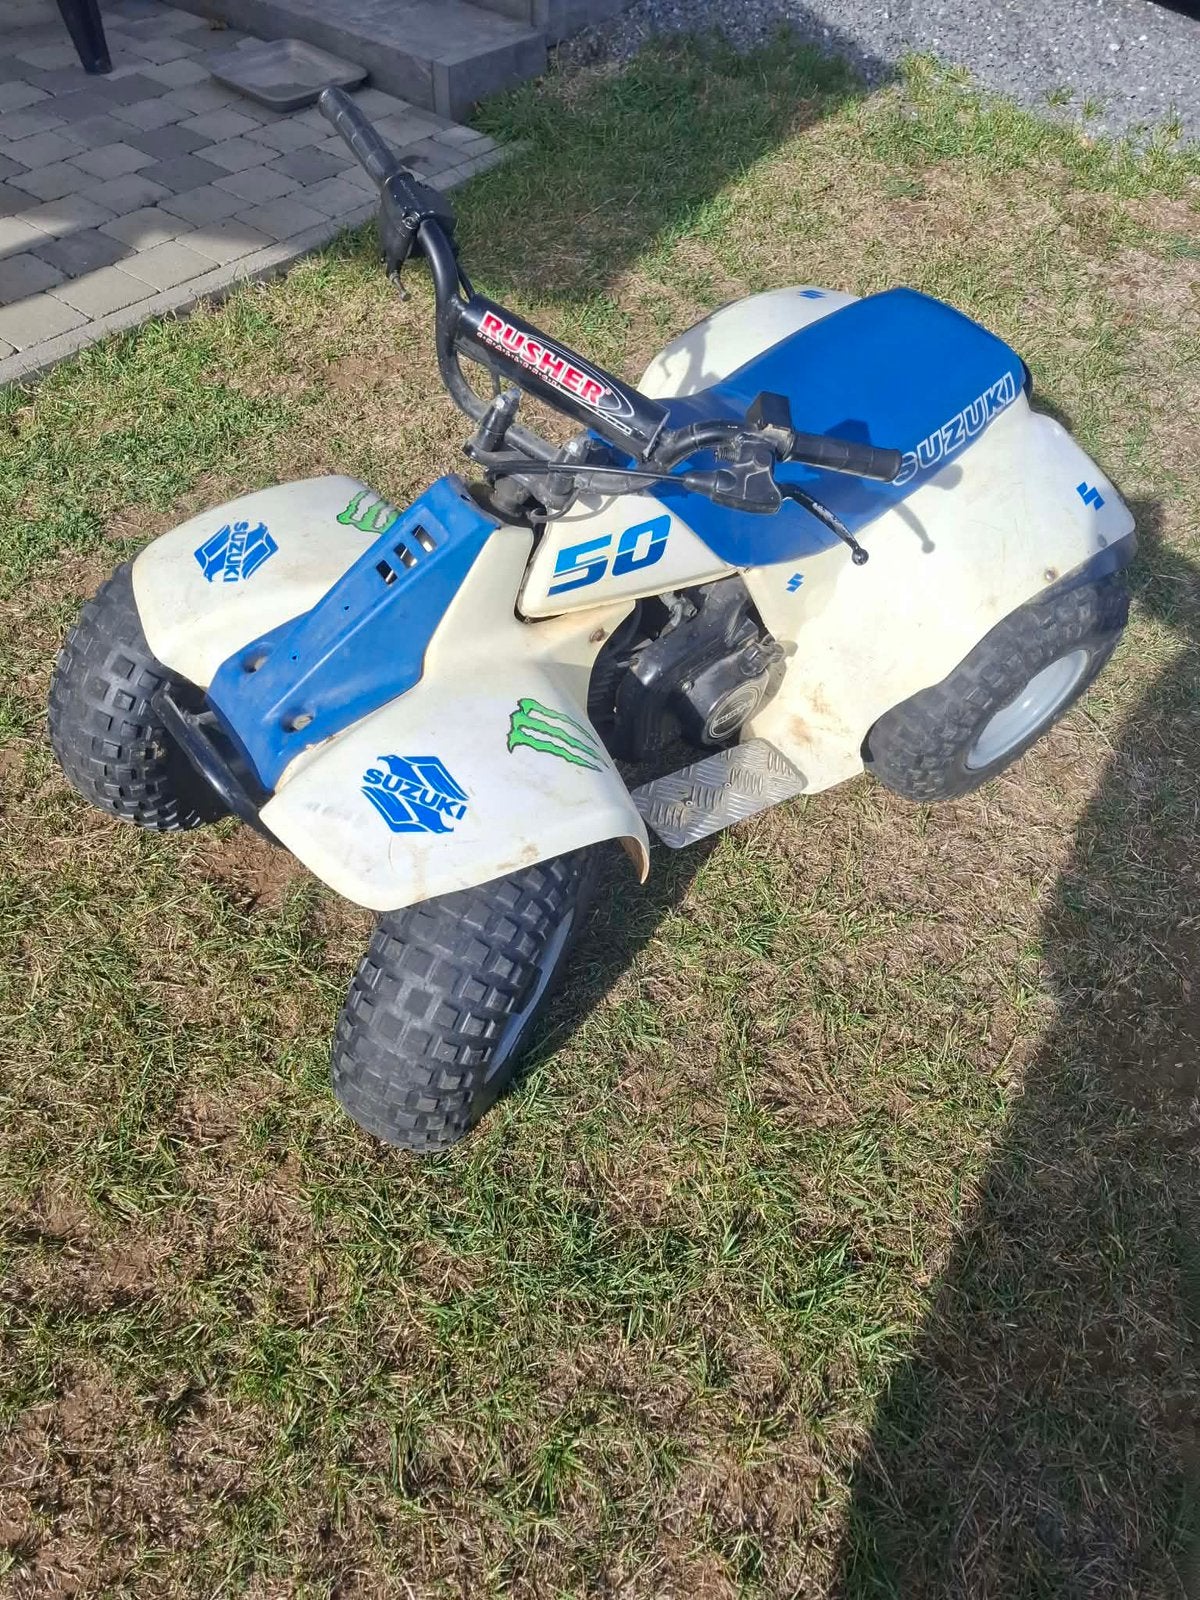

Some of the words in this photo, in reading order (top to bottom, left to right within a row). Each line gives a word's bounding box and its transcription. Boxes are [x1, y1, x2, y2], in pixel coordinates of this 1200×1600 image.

[477, 310, 603, 406] RUSHER
[888, 371, 1016, 487] SUZUKI
[223, 521, 249, 582] SUZUKI
[547, 514, 671, 597] 50
[363, 768, 467, 820] SUZUKI
